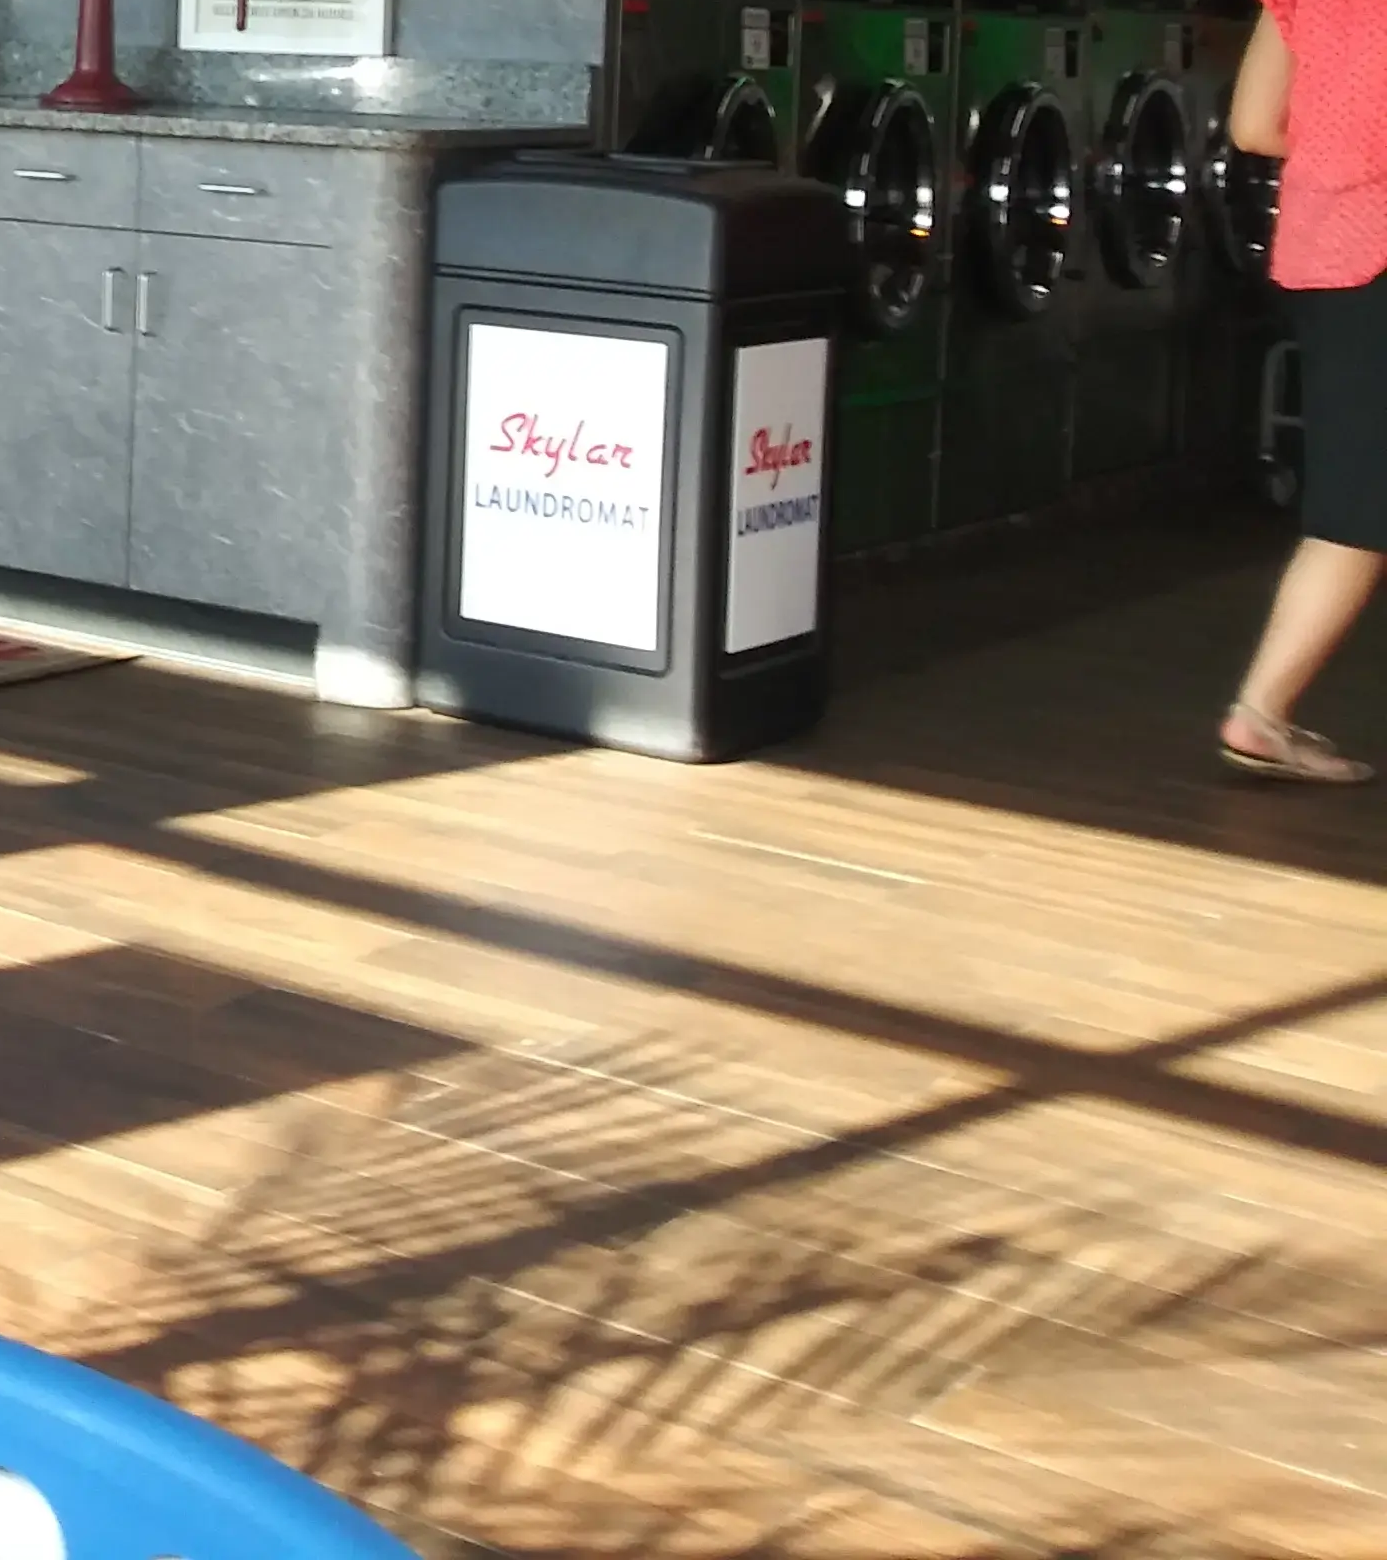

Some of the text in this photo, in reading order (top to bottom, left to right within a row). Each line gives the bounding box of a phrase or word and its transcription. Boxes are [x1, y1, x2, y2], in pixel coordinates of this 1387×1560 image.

[489, 412, 634, 479] Skylar
[744, 423, 813, 490] Skylar
[474, 482, 651, 531] LAUNDROMAT
[737, 494, 819, 537] LAUNDROMAT
